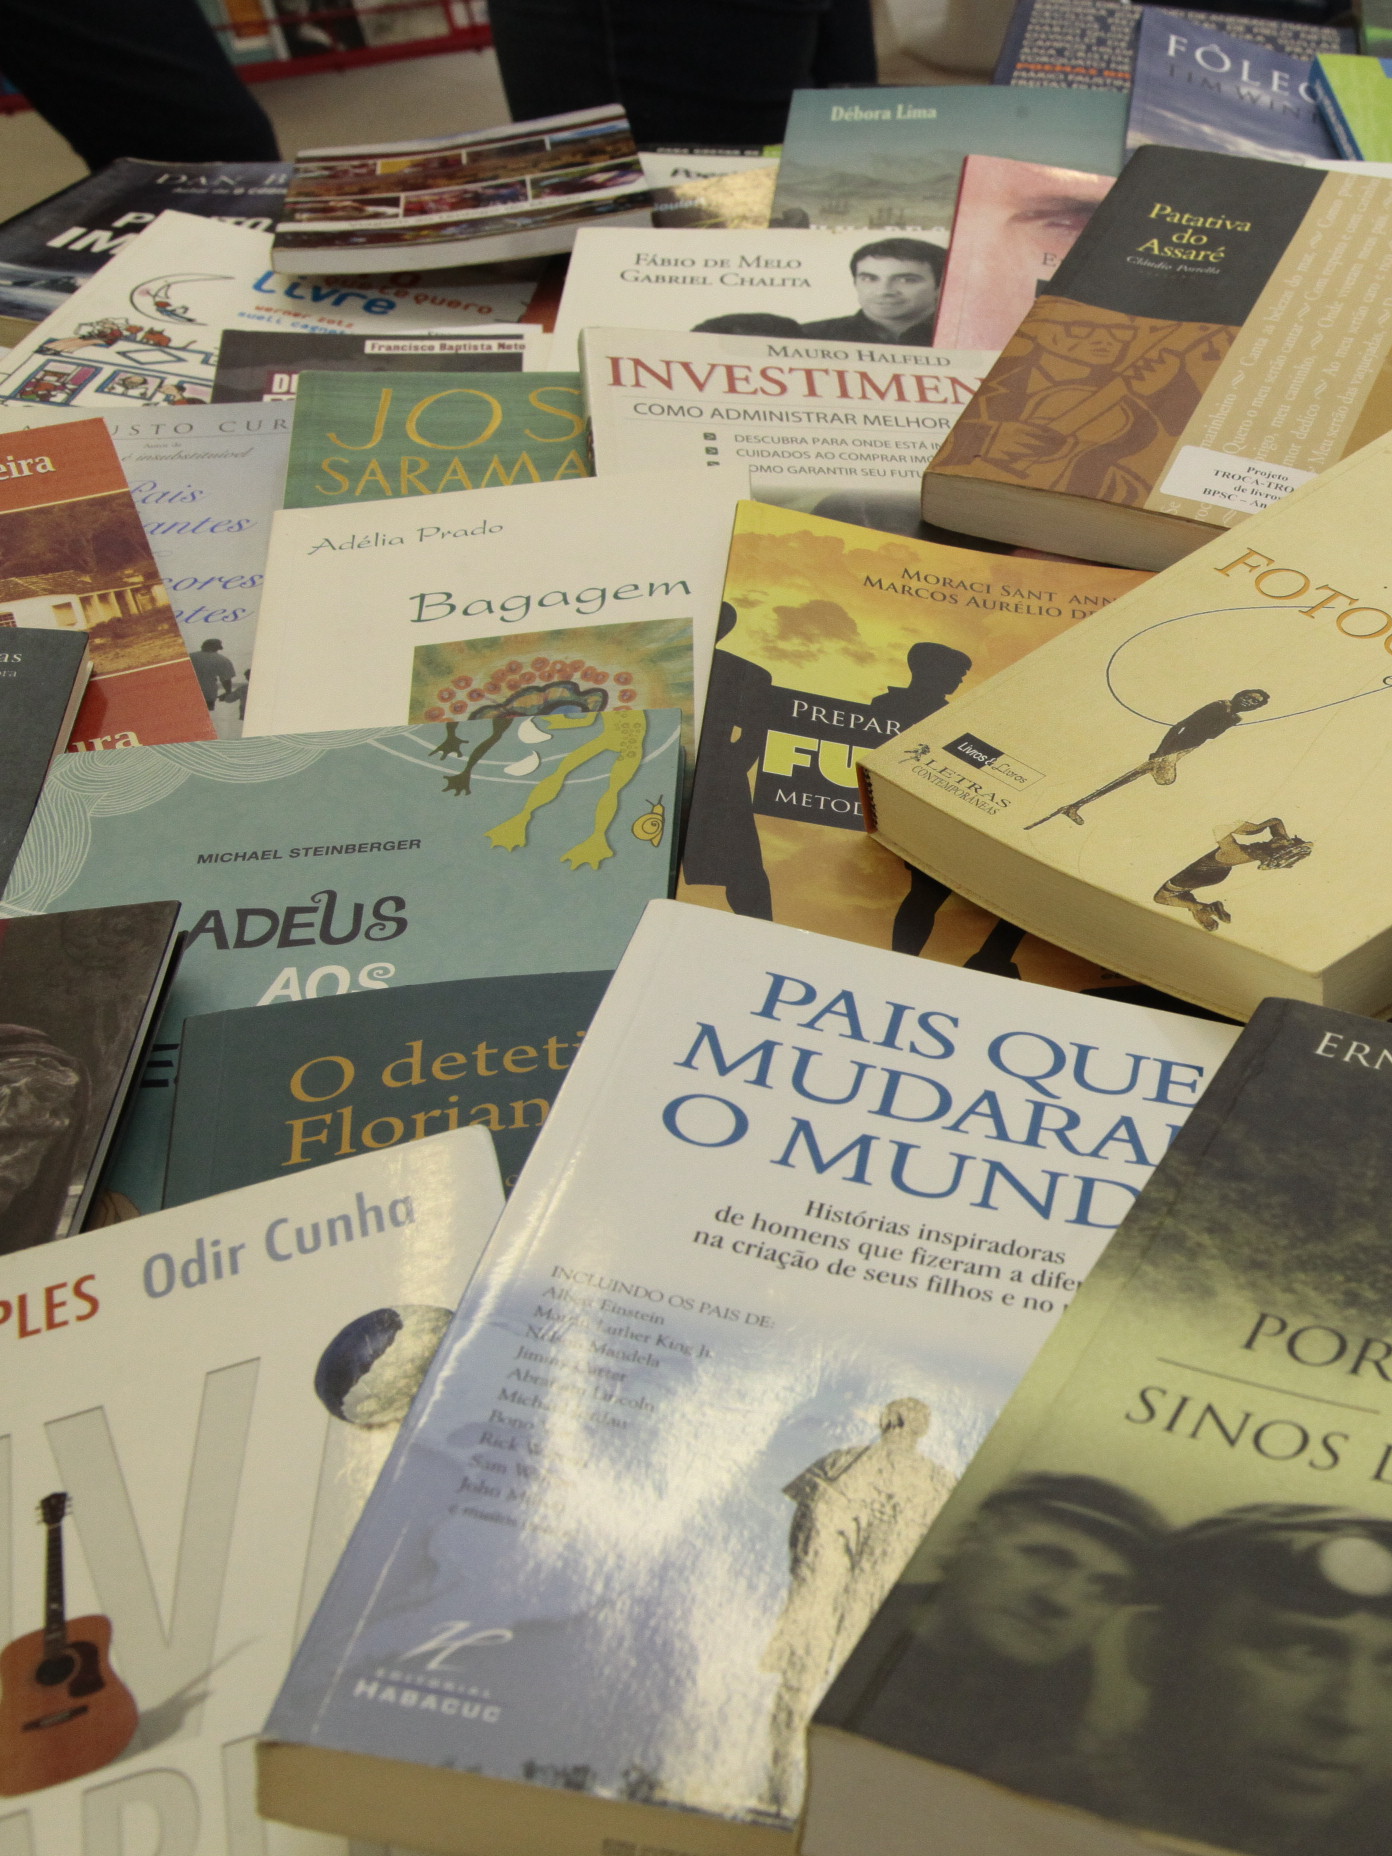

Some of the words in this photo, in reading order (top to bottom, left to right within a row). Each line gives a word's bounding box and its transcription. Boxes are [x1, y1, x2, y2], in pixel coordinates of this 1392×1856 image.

[1168, 64, 1221, 93] TIM
[831, 106, 891, 121] Débora
[896, 104, 937, 119] Lima
[1148, 202, 1252, 232] Patativa
[1137, 238, 1226, 263] Assaré
[1172, 229, 1208, 245] do
[371, 342, 436, 352] Francisco
[440, 342, 493, 354] Baptista
[498, 342, 526, 352] Neto
[633, 402, 703, 418] COMO
[711, 407, 857, 426] ADMINISTRAR
[863, 413, 951, 430] MELHOR
[734, 433, 809, 446] DESCUBRA
[812, 437, 847, 447] PARA
[852, 438, 891, 449] ONDE
[895, 438, 927, 450] ESTÁ
[736, 448, 811, 461] CUIDADOS
[815, 450, 835, 461] AO
[839, 452, 906, 464] COMPRAR
[786, 465, 858, 478] GARANTIR
[861, 467, 887, 478] SEU
[1233, 484, 1249, 494] de
[1246, 466, 1289, 482] Projeto
[1202, 487, 1238, 503] BPSC
[307, 532, 405, 555] Adélia
[416, 520, 504, 543] Prado
[409, 579, 692, 625] Bagagem
[863, 575, 960, 605] MARCOS
[966, 596, 1063, 618] AURÉLIO
[901, 567, 992, 594] MORACI
[1000, 585, 1058, 602] SANT
[956, 741, 988, 764] Livros
[911, 765, 1001, 817] CONTEMPORÂNEAS
[921, 758, 1012, 809] LETRAS
[196, 845, 284, 866] MICHAEL
[288, 838, 422, 860] STEINBERGER
[186, 889, 409, 951] ADEUS
[750, 971, 960, 1060] PAIS
[987, 1031, 1203, 1109] QUE
[290, 1055, 355, 1103] O
[661, 1093, 749, 1148] O
[143, 1237, 247, 1299] Odir
[265, 1192, 417, 1263] Cunha
[714, 1205, 745, 1227] de
[750, 1213, 851, 1252] homens
[858, 1238, 904, 1267] que
[910, 1247, 1001, 1280] fizeram
[804, 1200, 911, 1238] Histórias
[917, 1223, 1067, 1266] inspiradoras
[693, 1227, 725, 1250] na
[731, 1236, 819, 1272] criação
[827, 1256, 857, 1278] de
[863, 1267, 919, 1290] seus
[926, 1274, 994, 1305] filhos
[1022, 1296, 1054, 1314] no
[551, 1265, 665, 1303] INCLUINDO
[667, 1294, 695, 1312] OS
[699, 1301, 741, 1323] PAIS
[744, 1311, 777, 1331] DE:
[1123, 1383, 1351, 1475] SINOS
[353, 1678, 502, 1724] HABACUC
